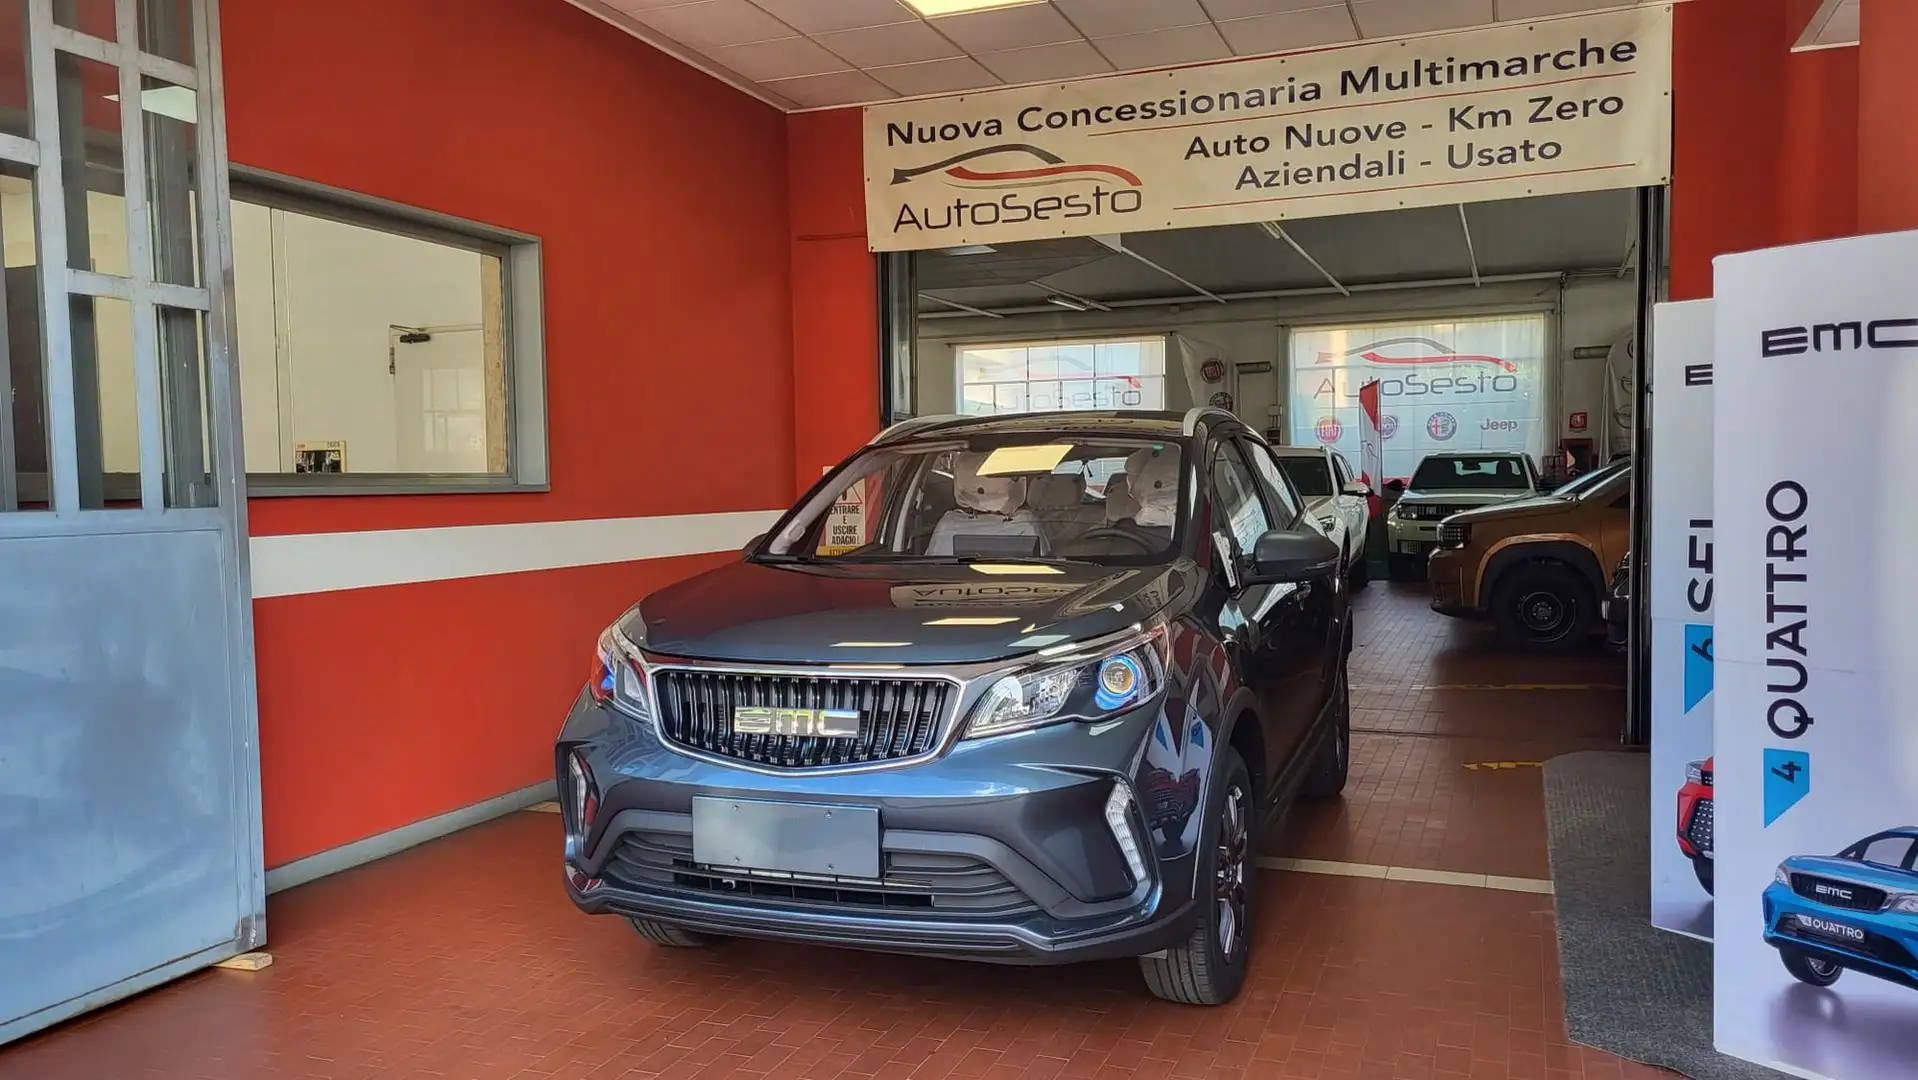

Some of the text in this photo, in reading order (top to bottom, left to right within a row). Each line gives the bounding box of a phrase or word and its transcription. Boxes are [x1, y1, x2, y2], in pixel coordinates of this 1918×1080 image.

[887, 37, 1638, 146] Nuova Concessionaria Multimarche
[1184, 134, 1270, 160] Auto
[1285, 121, 1407, 150] Nuove
[1449, 105, 1512, 132] Km
[1528, 95, 1624, 124] Zero
[1235, 149, 1405, 190] Aziendali
[1447, 139, 1562, 169] Usato
[893, 185, 1142, 233] AutoSesto
[1480, 418, 1518, 432] Jeep
[832, 525, 858, 535] USCIRE
[843, 515, 847, 524] E
[1765, 480, 1814, 784] 4 QUATTRO
[1812, 918, 1864, 940] QUATTRO
